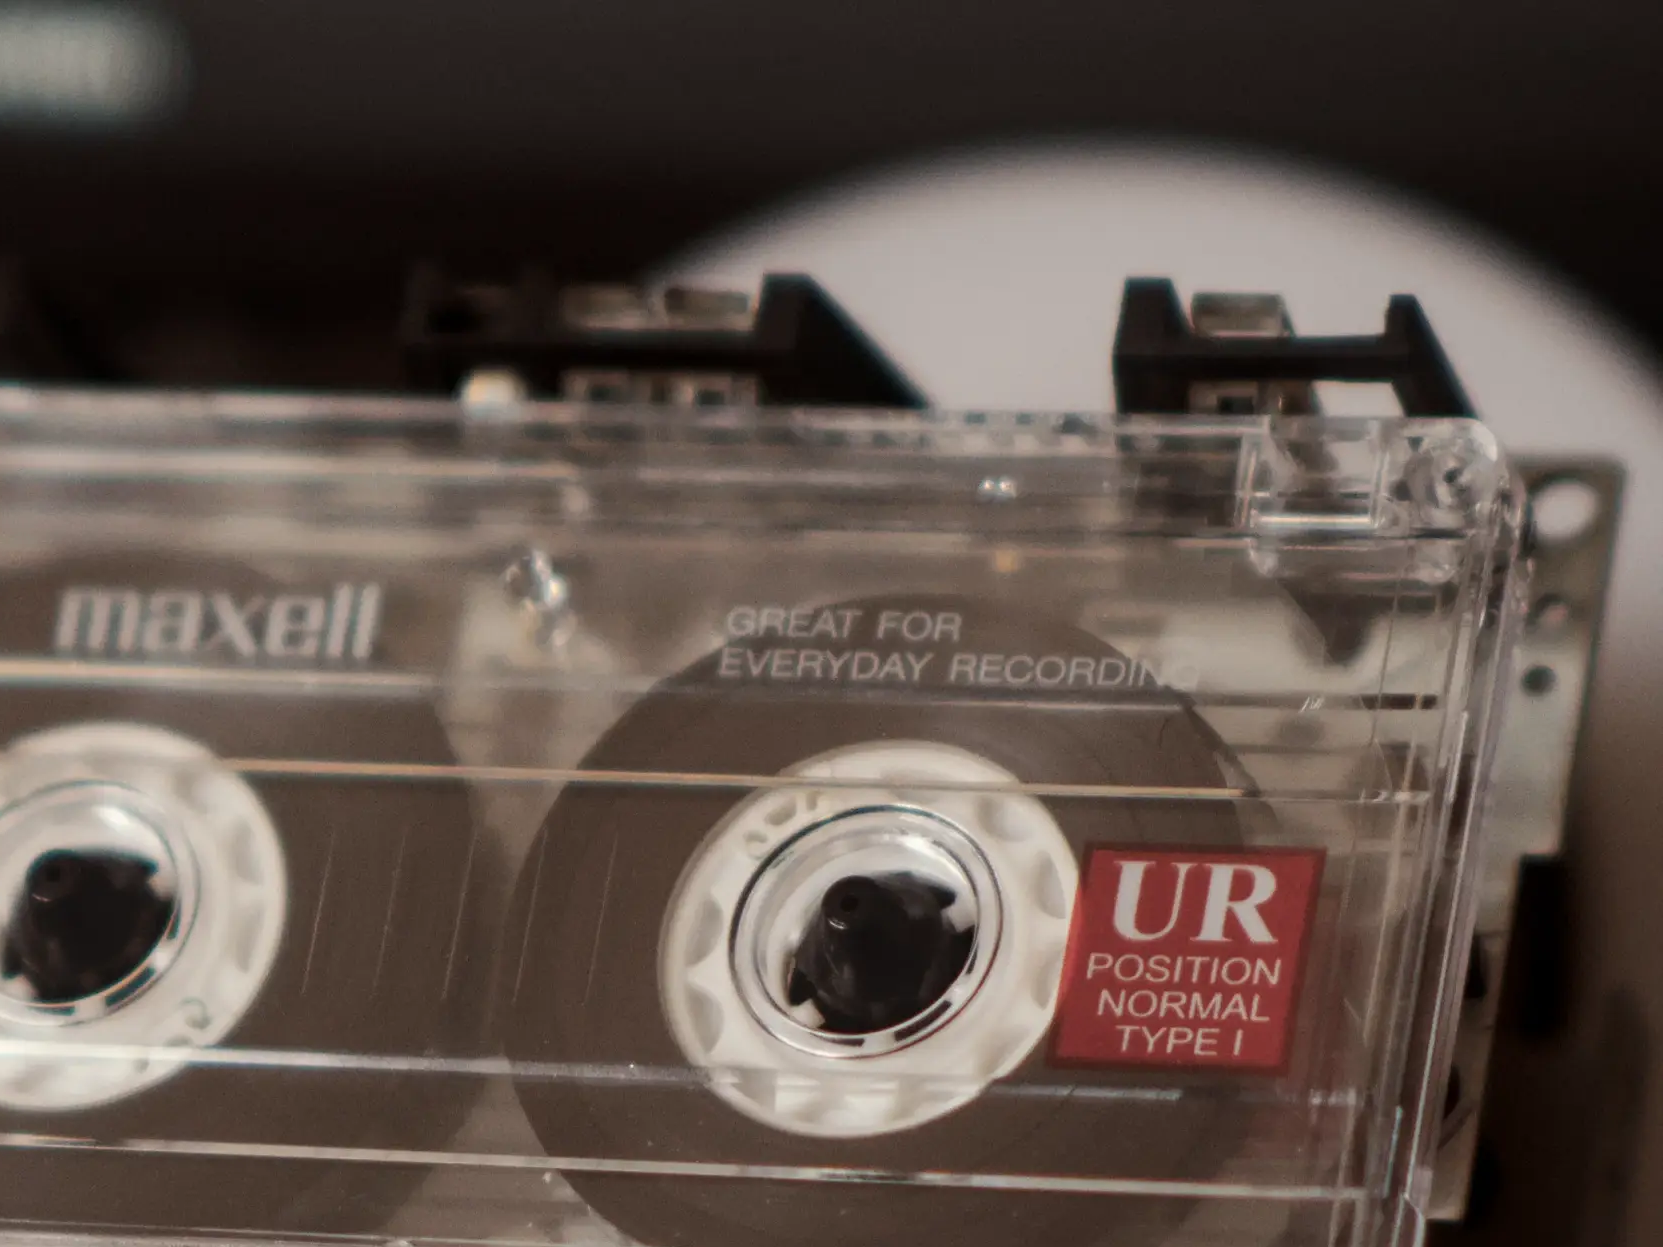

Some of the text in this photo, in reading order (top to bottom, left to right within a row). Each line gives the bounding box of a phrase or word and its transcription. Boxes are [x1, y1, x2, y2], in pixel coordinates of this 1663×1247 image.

[54, 581, 381, 659] maxell
[727, 606, 963, 642] GREAT FOR
[718, 649, 933, 682] EVERYDAY
[1113, 860, 1279, 943] UR
[1087, 952, 1282, 986] POSITION
[1097, 988, 1270, 1022] NORMAL
[1116, 1025, 1244, 1056] TYPE I
